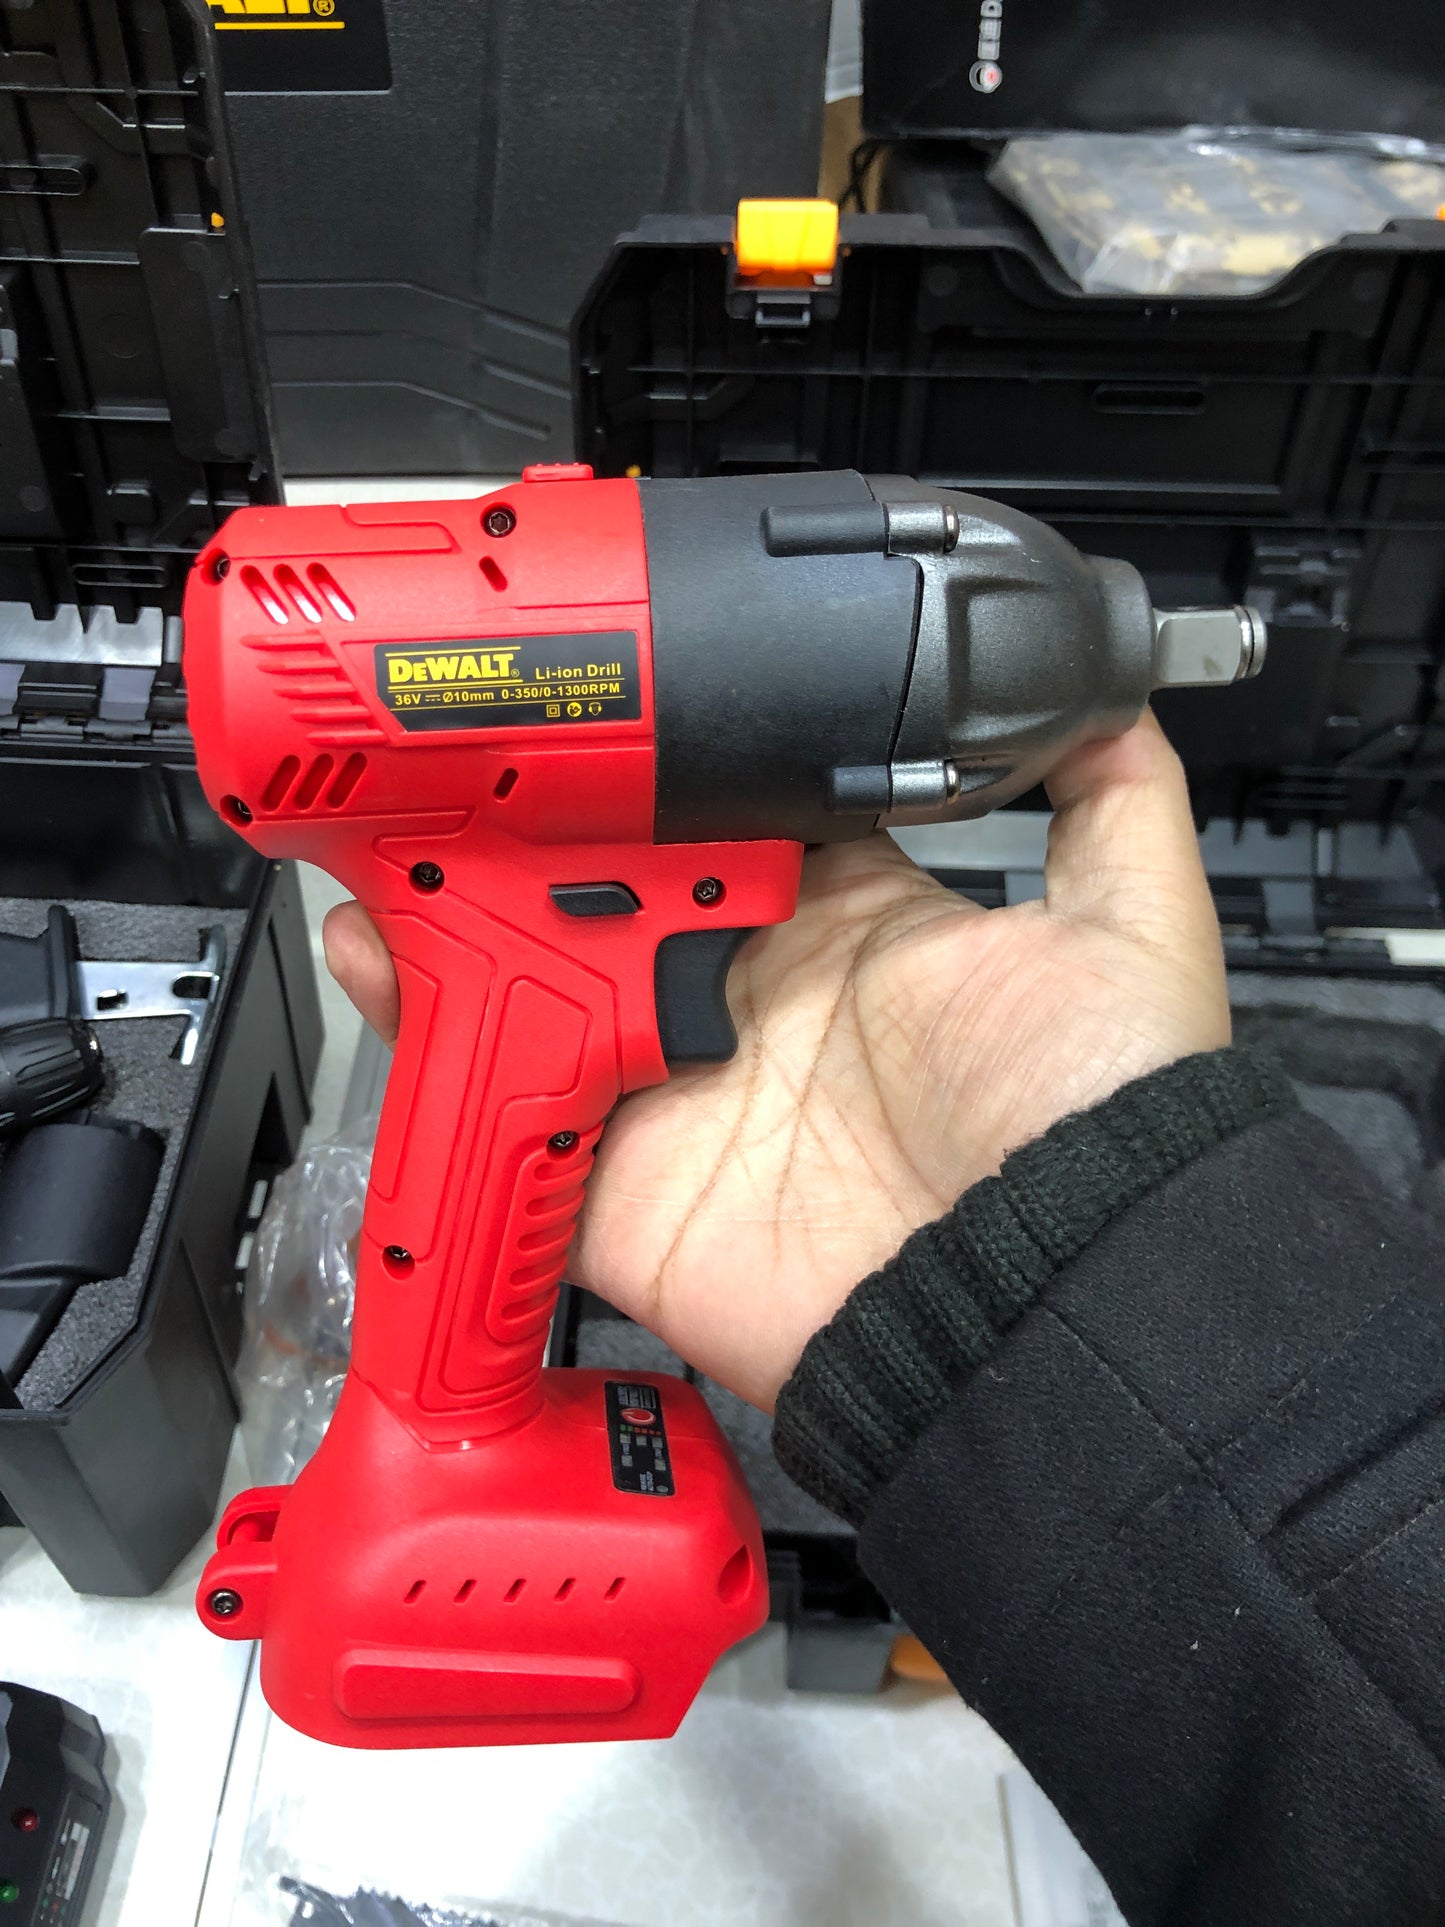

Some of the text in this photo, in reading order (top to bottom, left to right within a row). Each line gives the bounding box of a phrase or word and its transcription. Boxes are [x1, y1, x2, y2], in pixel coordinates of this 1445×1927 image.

[535, 662, 621, 680] Li-ion Drill
[395, 693, 421, 705] 36V
[501, 682, 620, 700] 0-350/0-1300RPM
